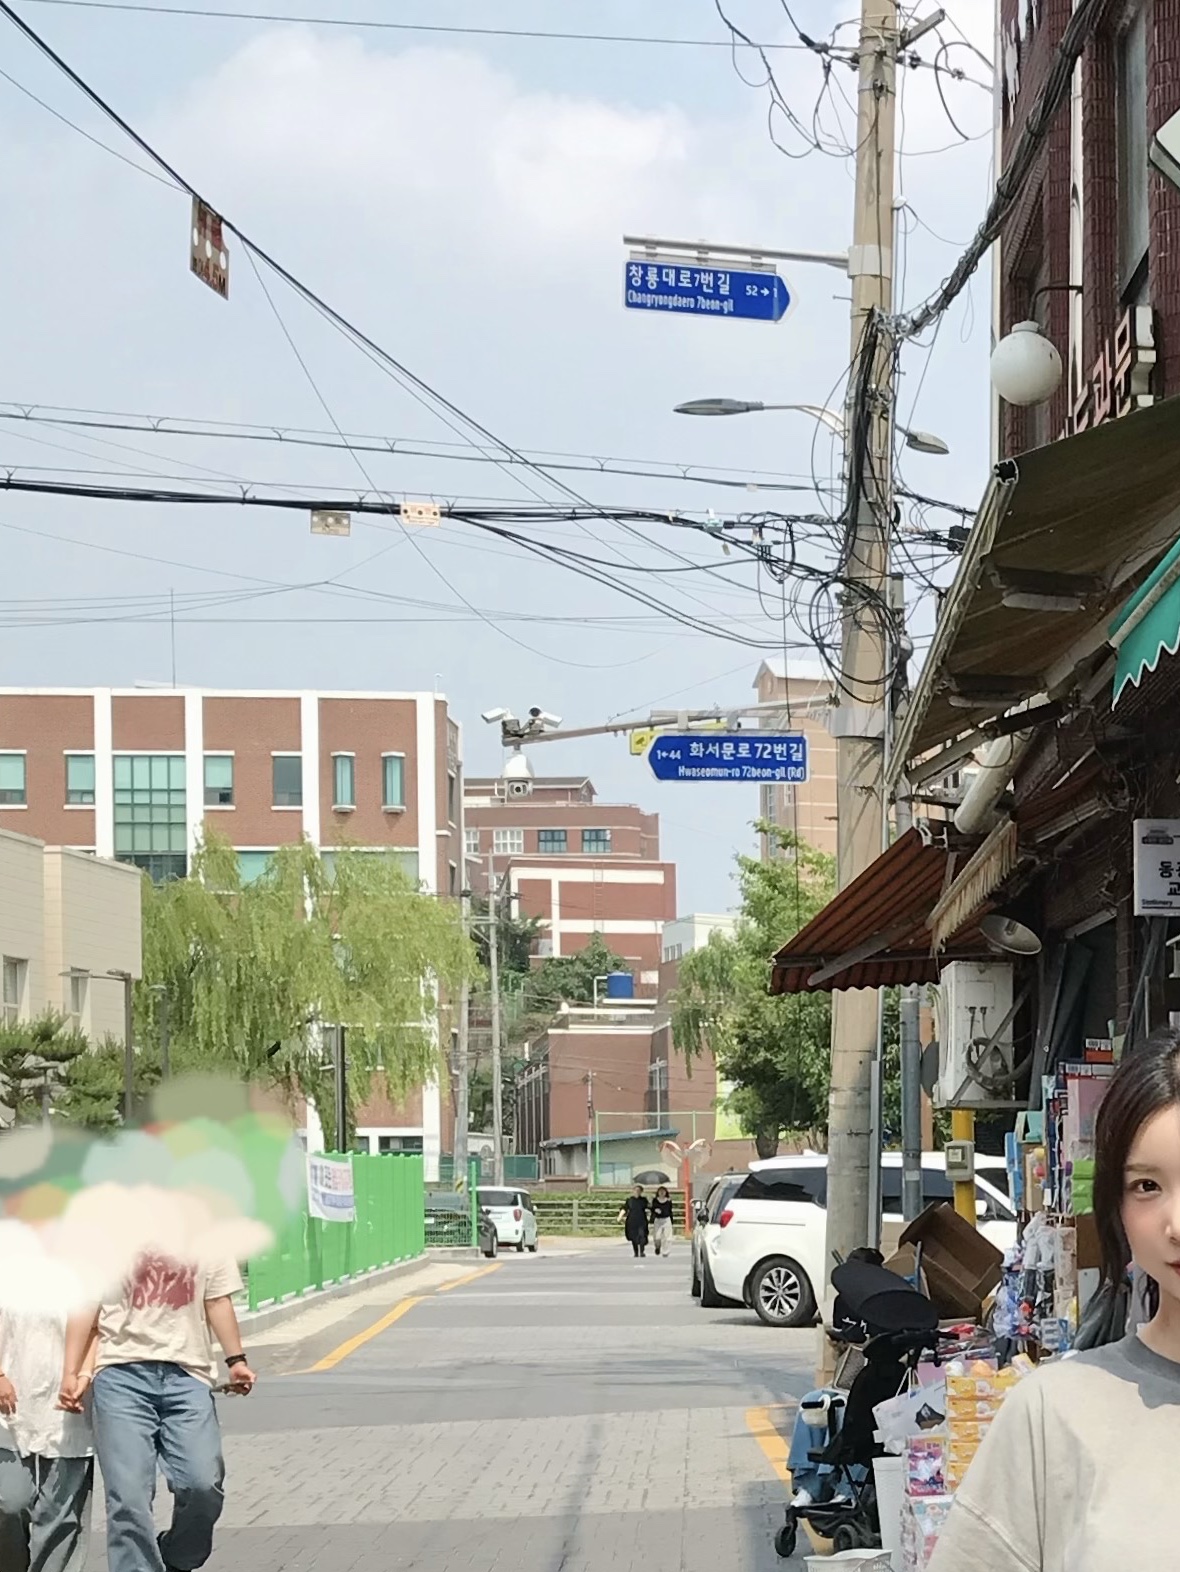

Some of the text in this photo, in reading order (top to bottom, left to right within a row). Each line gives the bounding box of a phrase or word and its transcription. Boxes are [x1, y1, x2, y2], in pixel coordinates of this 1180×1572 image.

[629, 264, 730, 295] 창룡대로7번길
[745, 284, 758, 296] 52
[628, 289, 734, 314] Changryongdaero 7beon-gil
[669, 750, 681, 760] 44
[689, 742, 803, 761] 화서문로 72번길
[678, 765, 805, 780] Hwaseomun-ro 72beon-gil (Rd)
